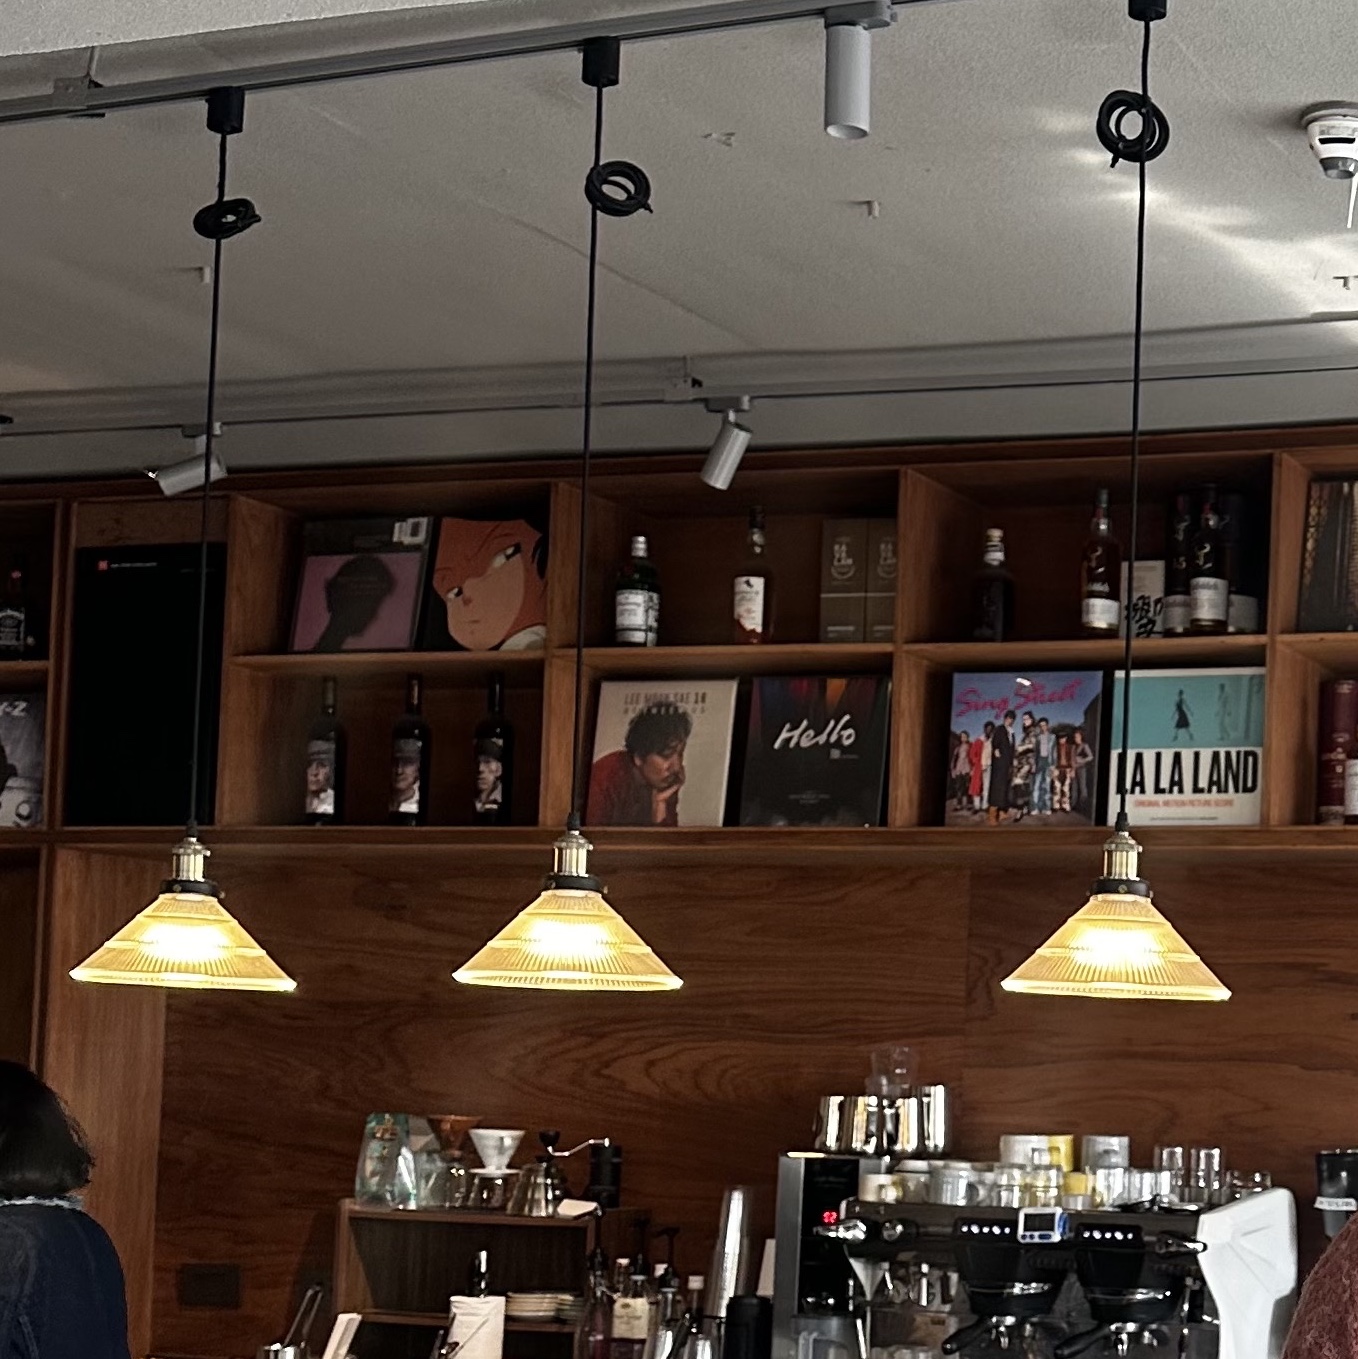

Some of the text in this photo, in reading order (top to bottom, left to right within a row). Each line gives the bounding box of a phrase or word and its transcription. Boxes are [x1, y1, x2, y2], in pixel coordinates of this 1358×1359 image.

[773, 713, 856, 750] Hello
[1154, 751, 1184, 795] LA
[1192, 750, 1259, 794] LAND
